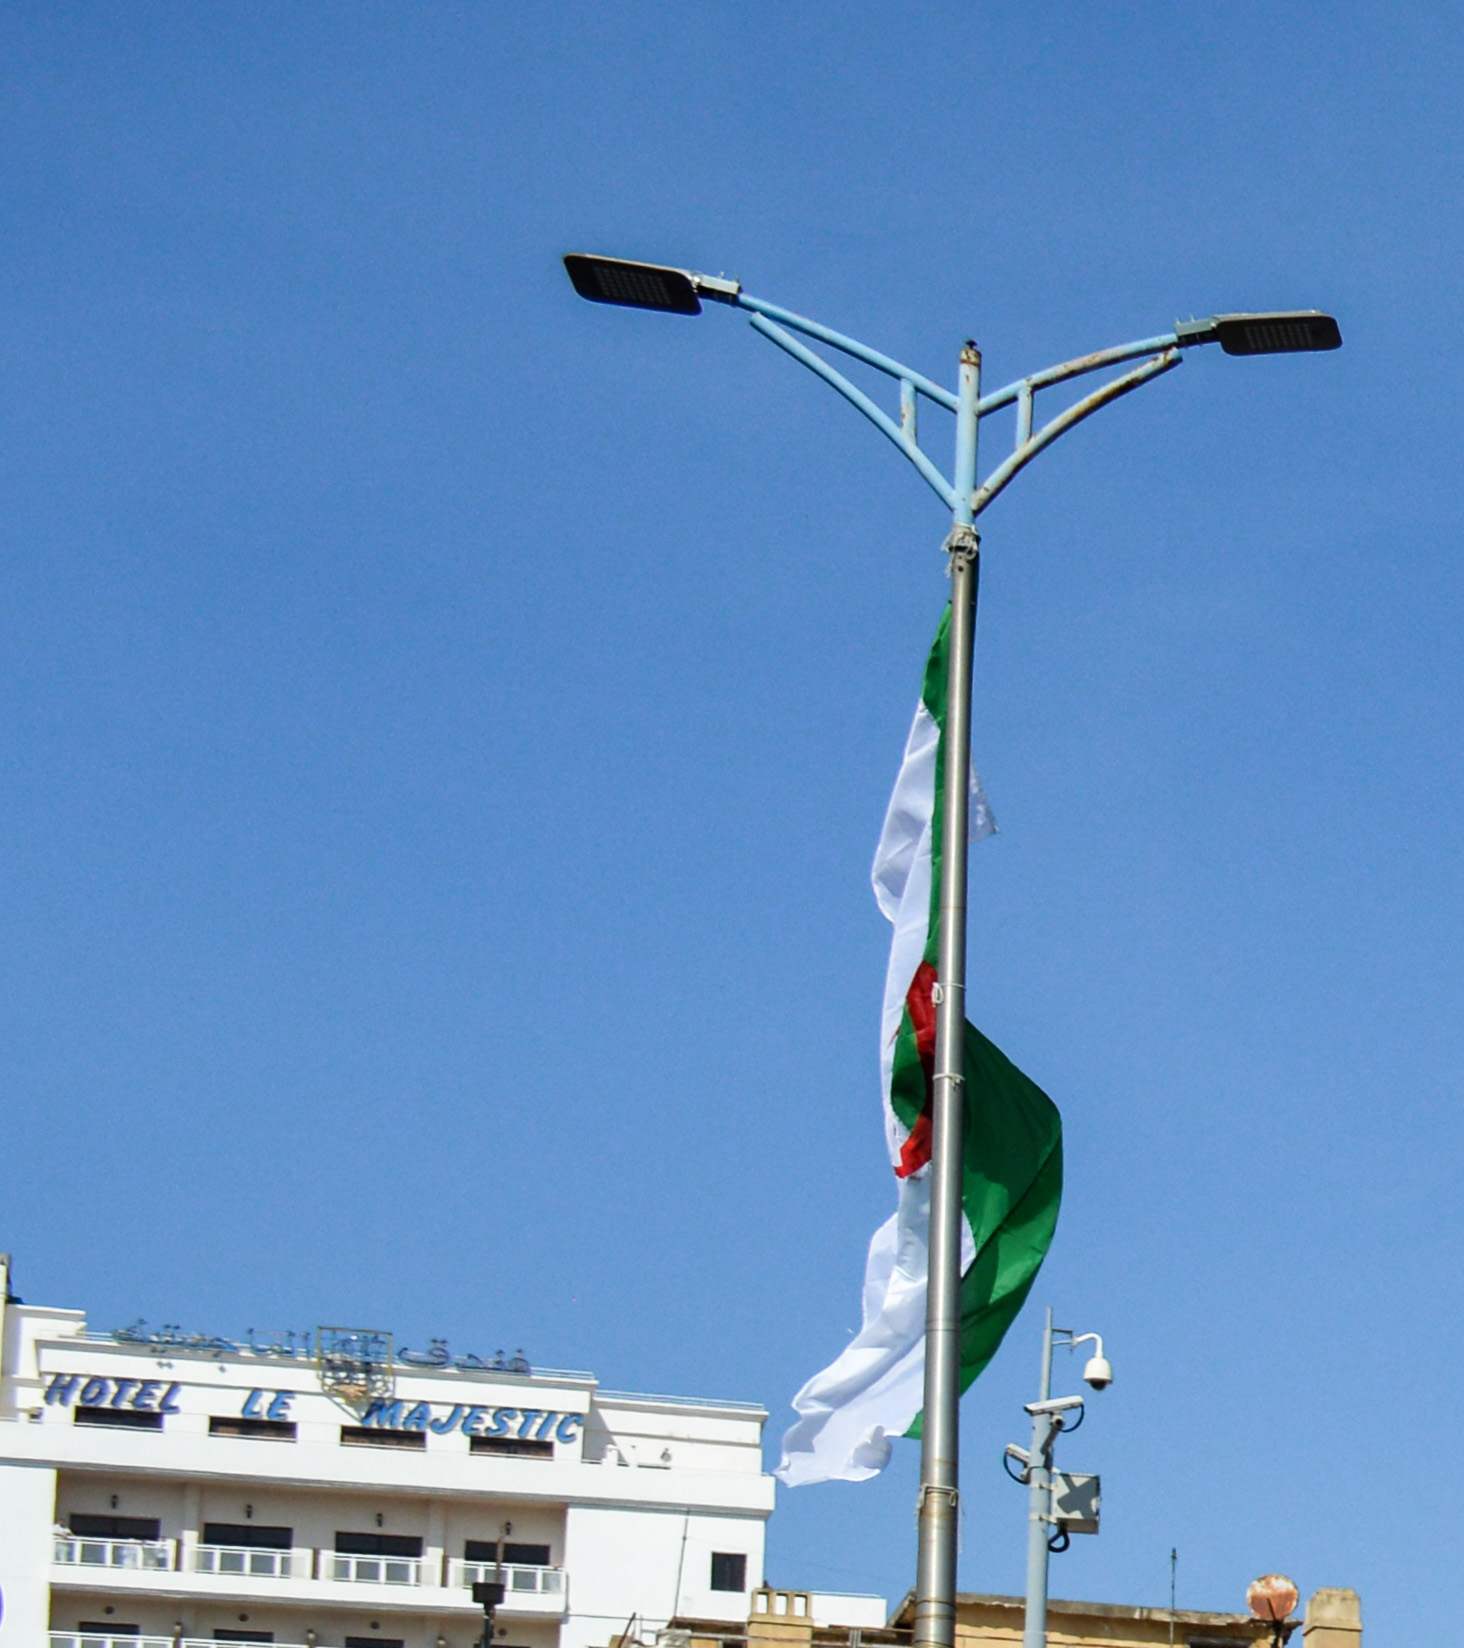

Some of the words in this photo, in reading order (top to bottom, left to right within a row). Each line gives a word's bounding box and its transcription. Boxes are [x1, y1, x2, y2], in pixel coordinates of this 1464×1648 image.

[43, 1373, 183, 1415] HOTEL
[240, 1387, 297, 1422] LE
[360, 1398, 586, 1445] MAJESTIC
